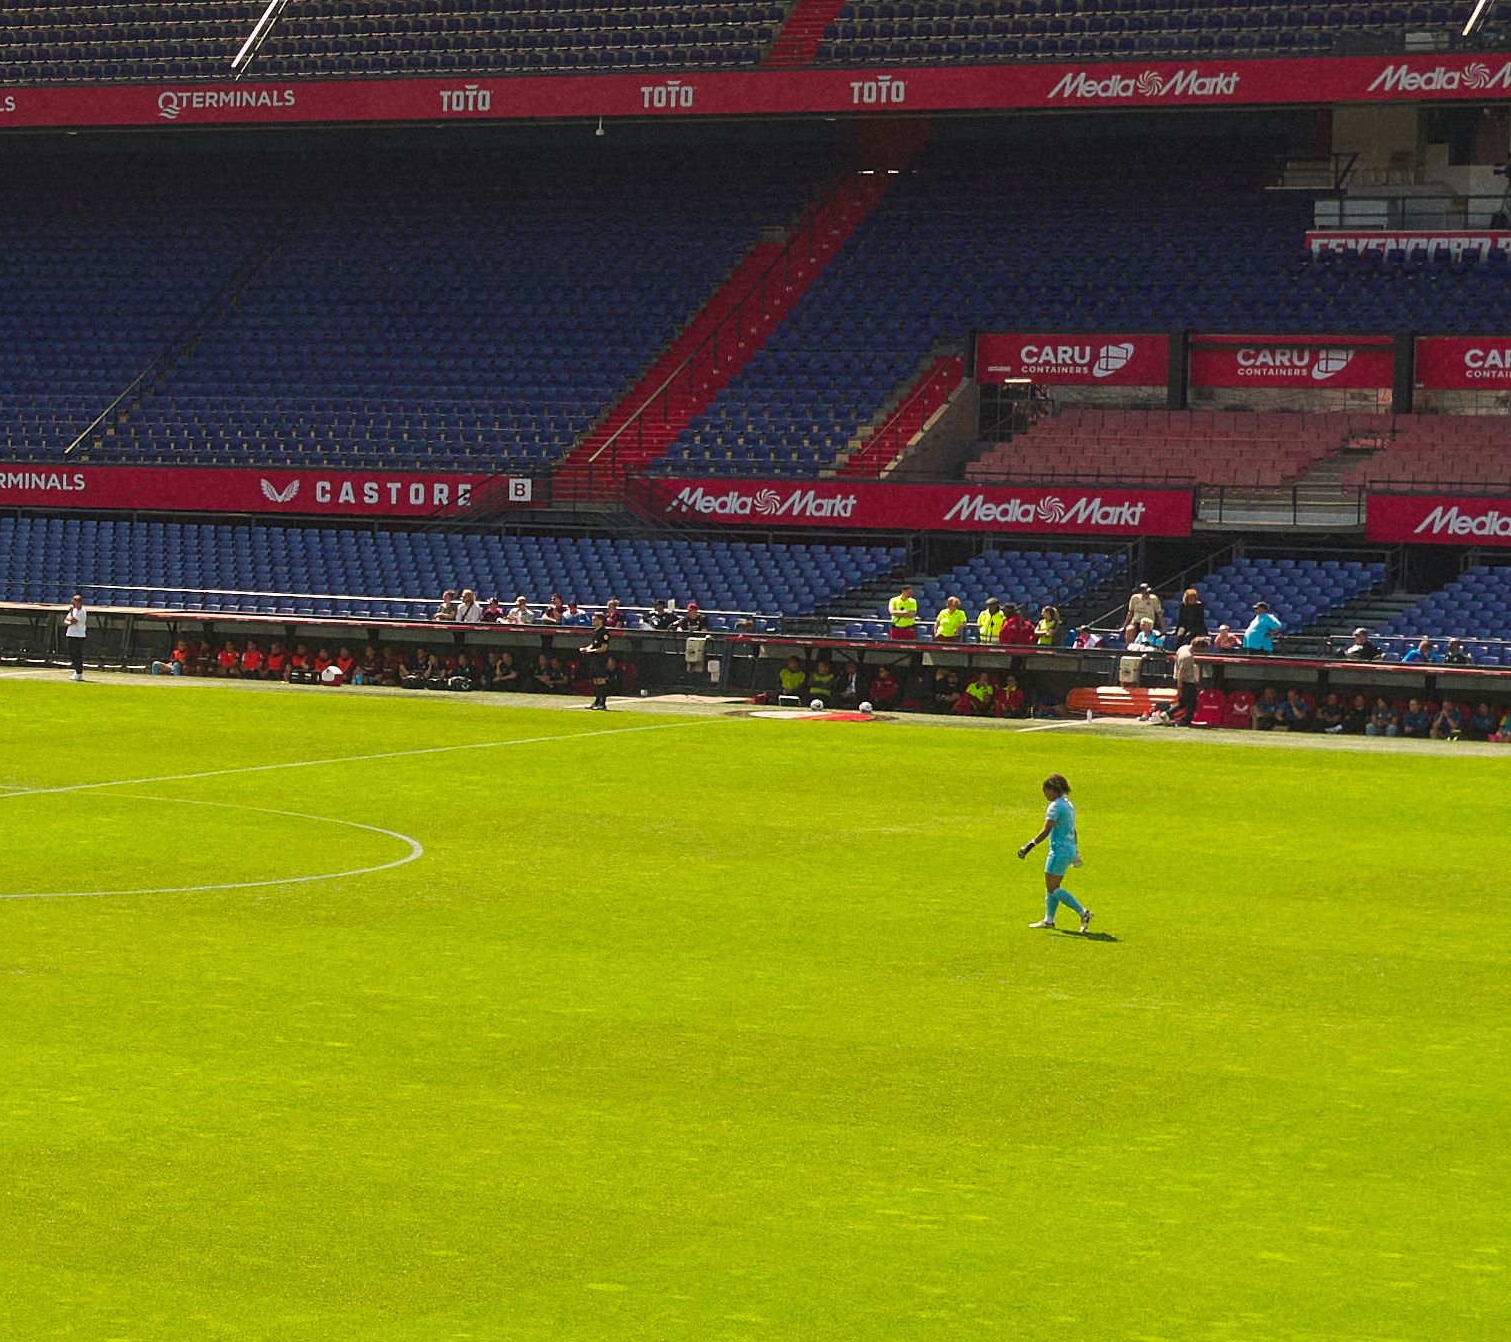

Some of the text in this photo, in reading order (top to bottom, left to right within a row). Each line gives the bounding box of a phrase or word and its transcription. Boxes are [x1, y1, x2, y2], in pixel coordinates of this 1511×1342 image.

[157, 89, 296, 119] QTERMINALS
[1020, 345, 1091, 364] CARU
[1237, 348, 1309, 367] CARU
[1021, 365, 1089, 375] CONTAINERS
[1237, 367, 1308, 377] CONTAINERS
[315, 481, 472, 506] CASTORE
